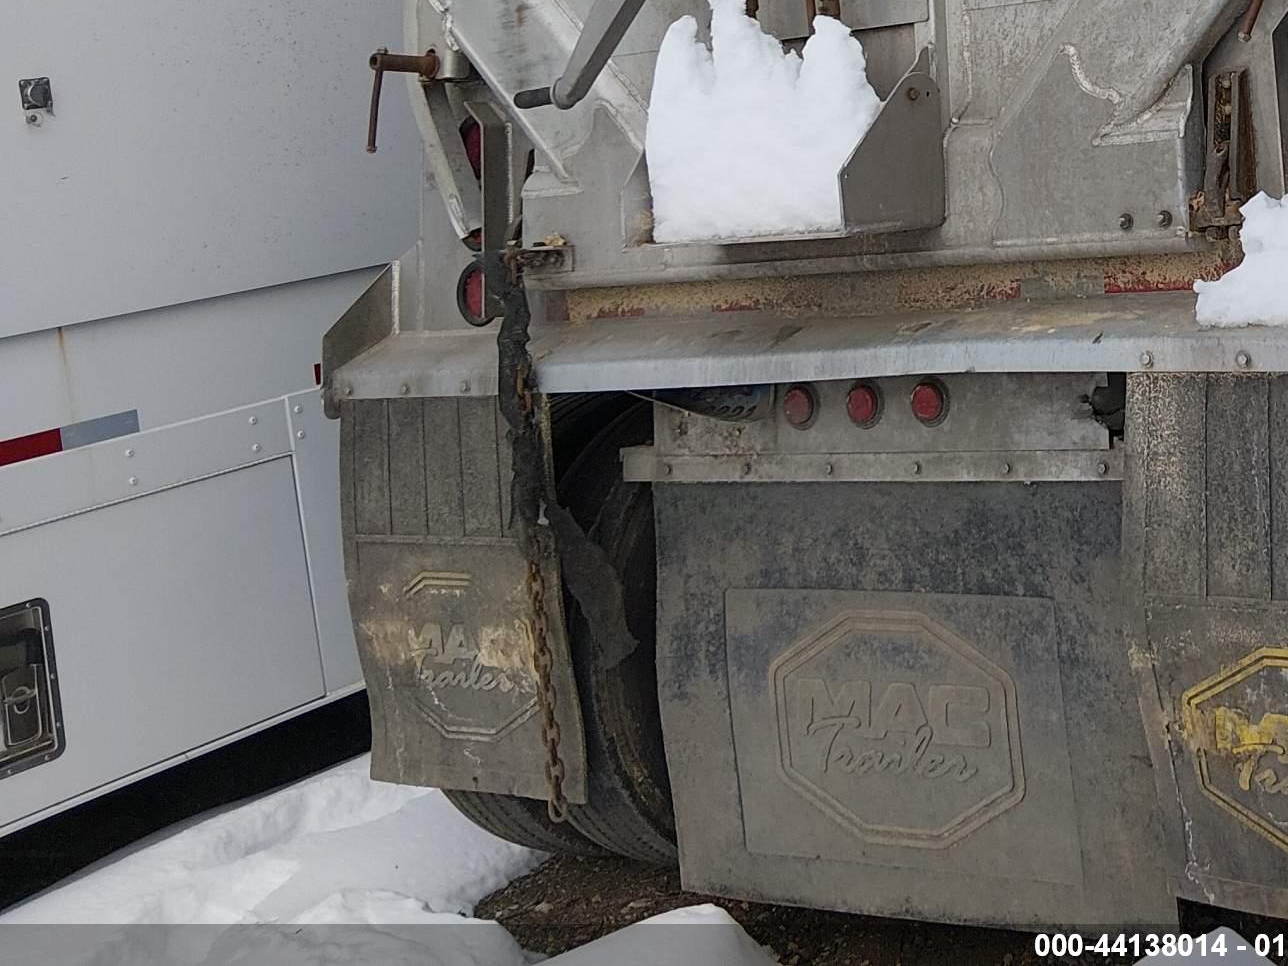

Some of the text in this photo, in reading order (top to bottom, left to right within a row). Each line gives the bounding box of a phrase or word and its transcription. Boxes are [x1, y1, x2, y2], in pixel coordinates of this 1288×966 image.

[408, 622, 516, 666] MA
[797, 678, 991, 747] MAC
[806, 715, 977, 782] Trailer
